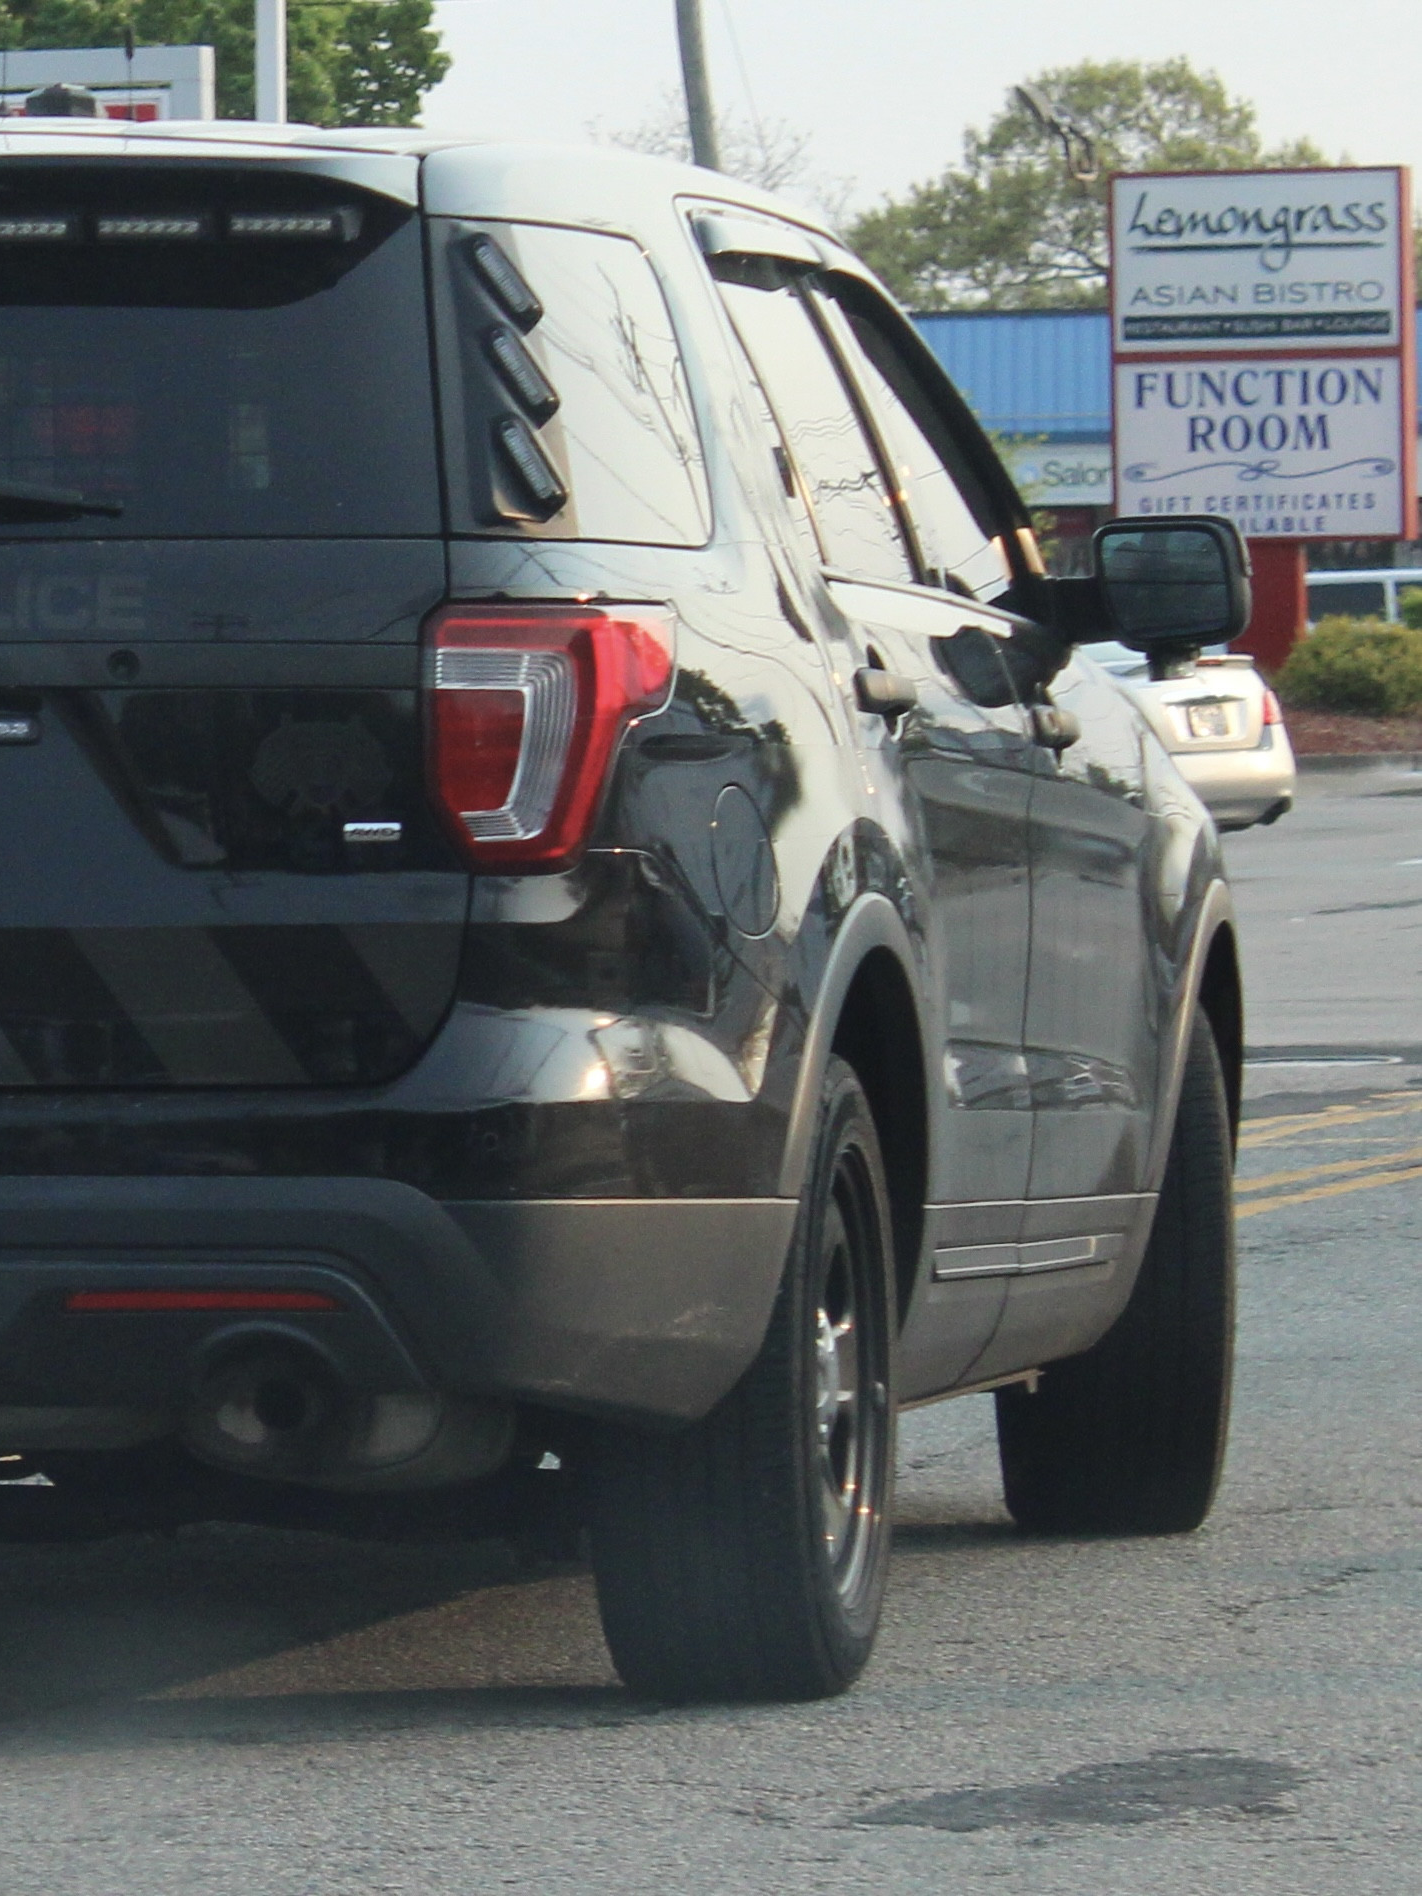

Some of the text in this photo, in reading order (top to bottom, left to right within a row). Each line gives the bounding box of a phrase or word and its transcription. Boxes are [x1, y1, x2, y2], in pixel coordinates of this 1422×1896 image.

[1129, 191, 1386, 272] Lemongrass
[1131, 280, 1385, 306] ASIAN BISTRO
[1134, 367, 1383, 409] FUNCTION
[1187, 413, 1331, 452] ROOM
[1138, 492, 1376, 514] GIFT CERTIFICATES
[1238, 515, 1327, 534] ILABLE
